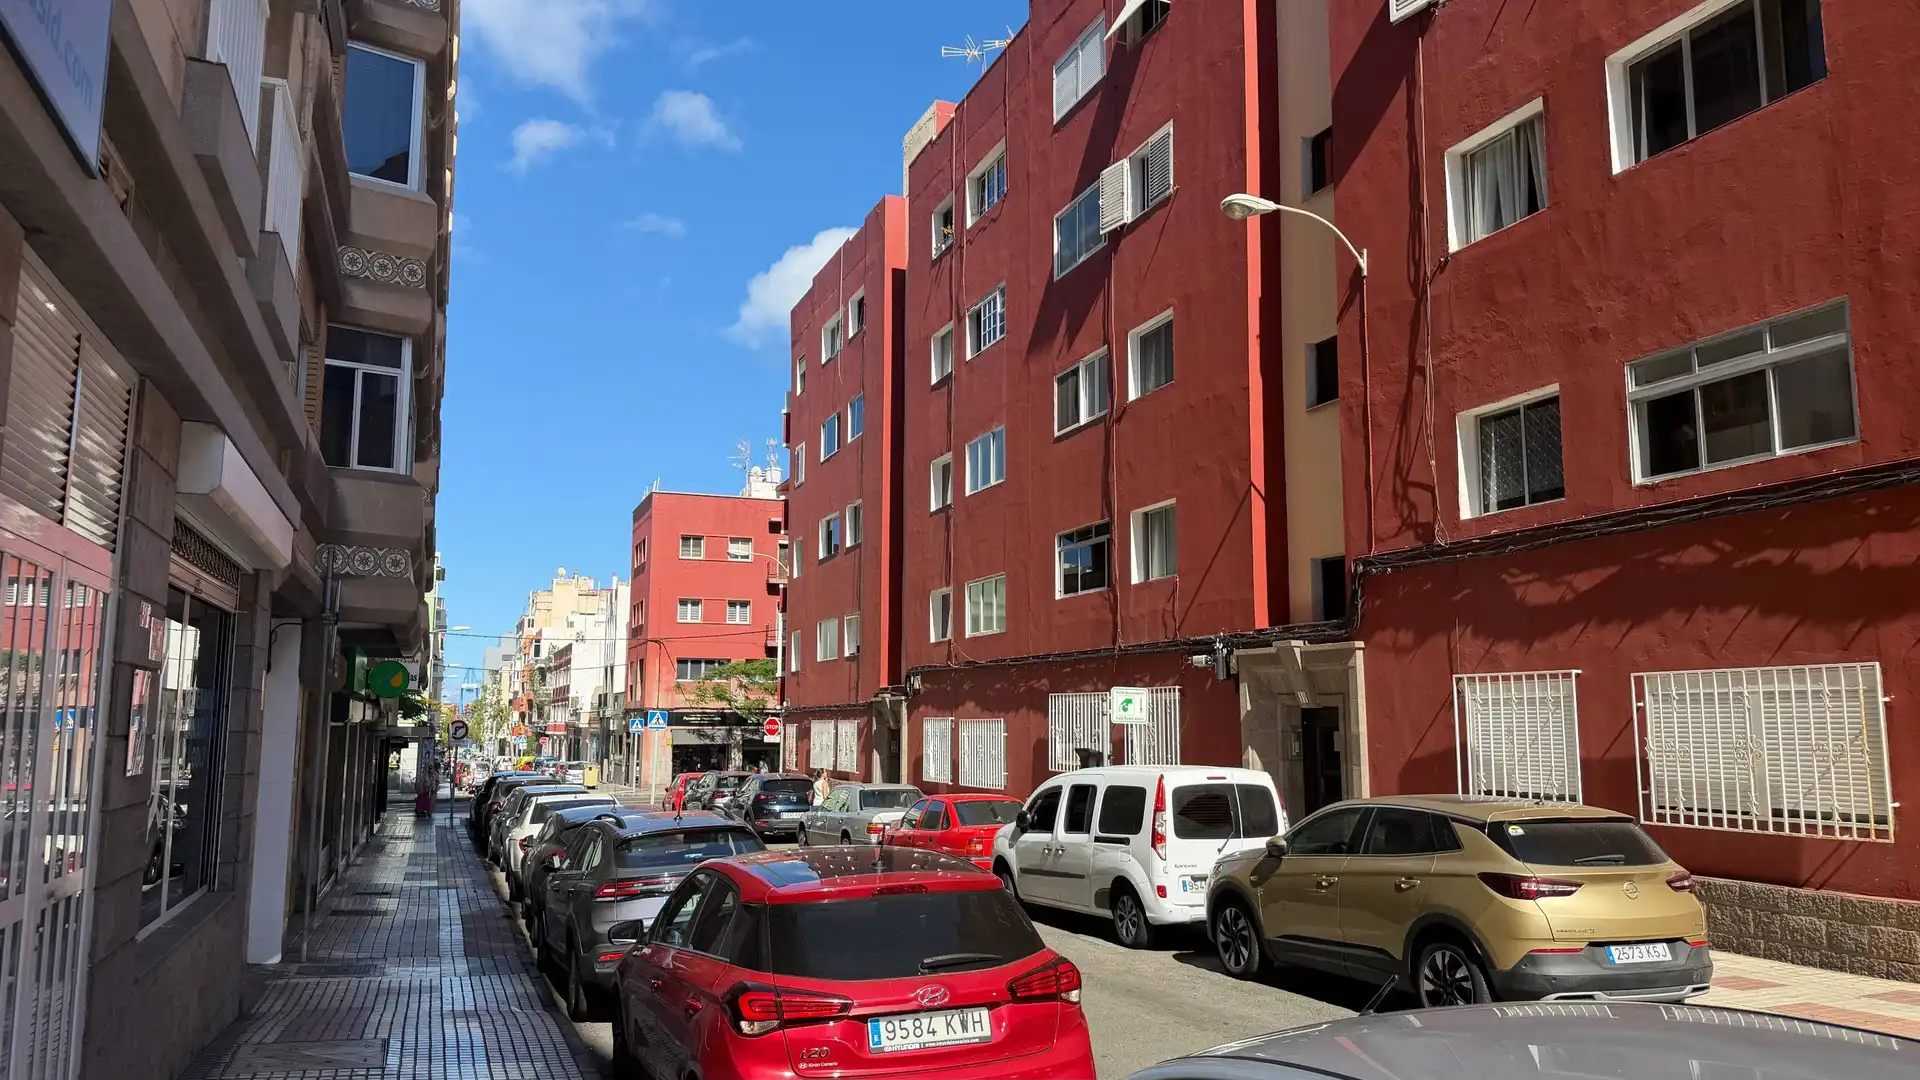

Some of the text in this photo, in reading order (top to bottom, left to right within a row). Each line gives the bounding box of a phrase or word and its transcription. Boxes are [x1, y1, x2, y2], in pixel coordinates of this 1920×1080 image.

[30, 0, 93, 114] sid.com
[1188, 880, 1206, 891] 954
[1614, 943, 1668, 961] 2573 KSJ
[884, 1011, 985, 1041] 9584 KWH
[892, 1043, 920, 1052] HYUNDAI
